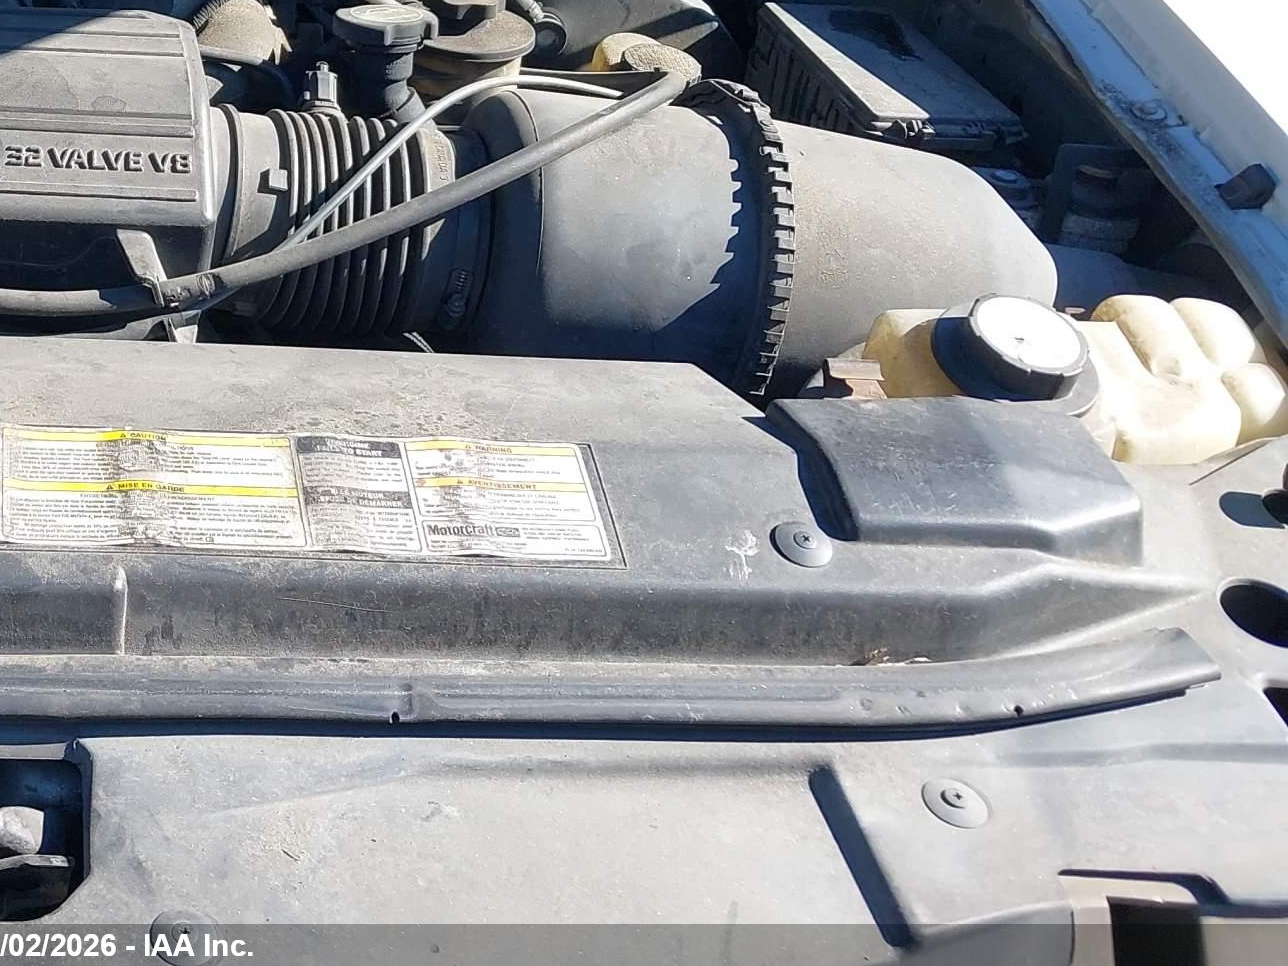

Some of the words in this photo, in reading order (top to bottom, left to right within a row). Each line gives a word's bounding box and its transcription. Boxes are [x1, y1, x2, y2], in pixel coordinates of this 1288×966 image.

[3, 144, 43, 167] 32
[47, 147, 144, 172] VALVE
[148, 152, 193, 174] V8
[355, 449, 383, 457] START
